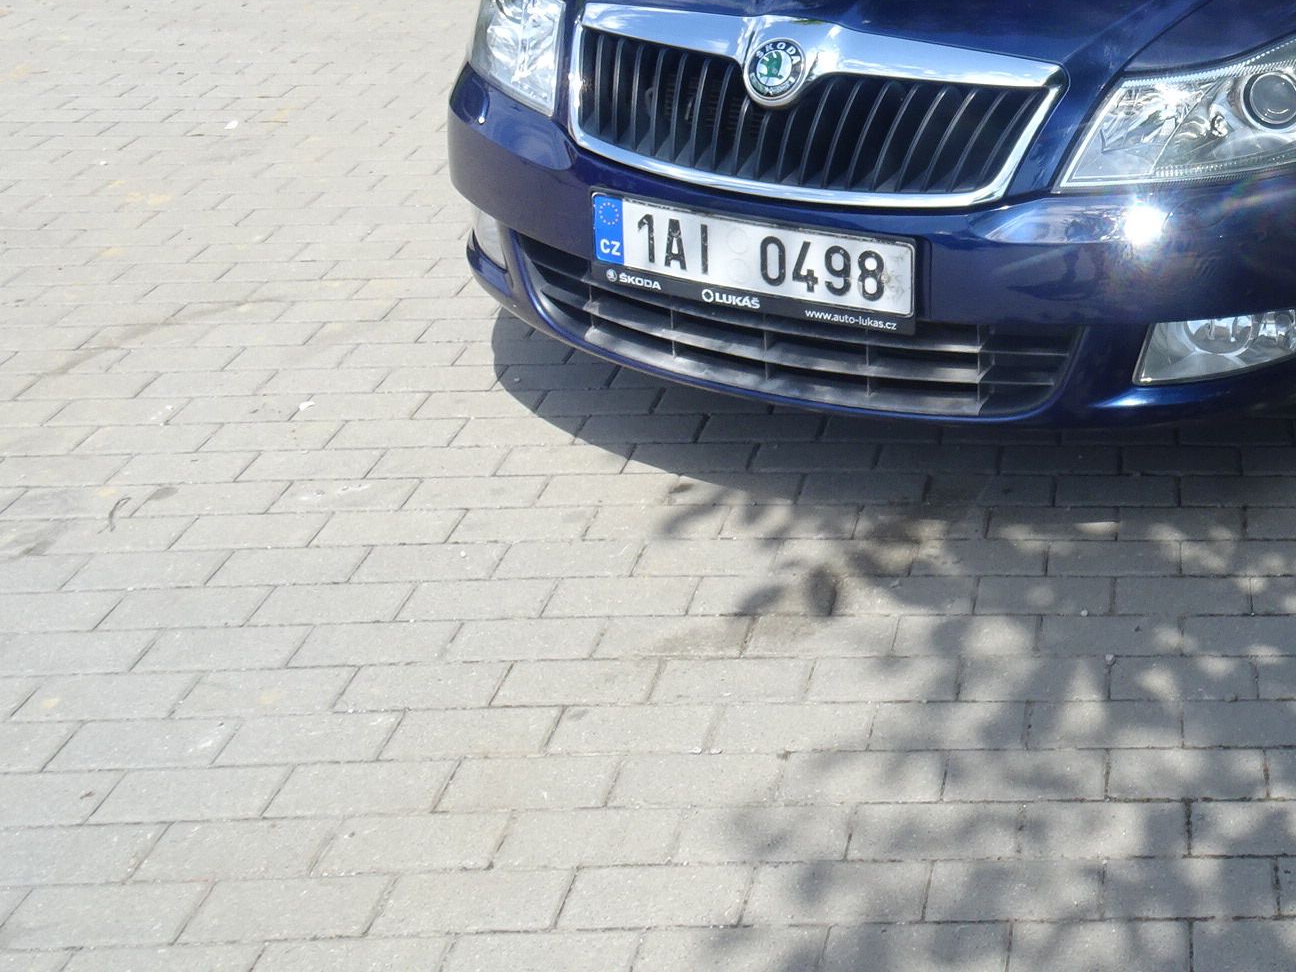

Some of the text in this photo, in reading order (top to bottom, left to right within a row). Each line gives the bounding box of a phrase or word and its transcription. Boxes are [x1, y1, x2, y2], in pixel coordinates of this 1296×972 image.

[599, 238, 622, 257] CZ
[637, 213, 885, 302] 1AI 0498
[804, 307, 898, 331] www.auto-lukas.cz
